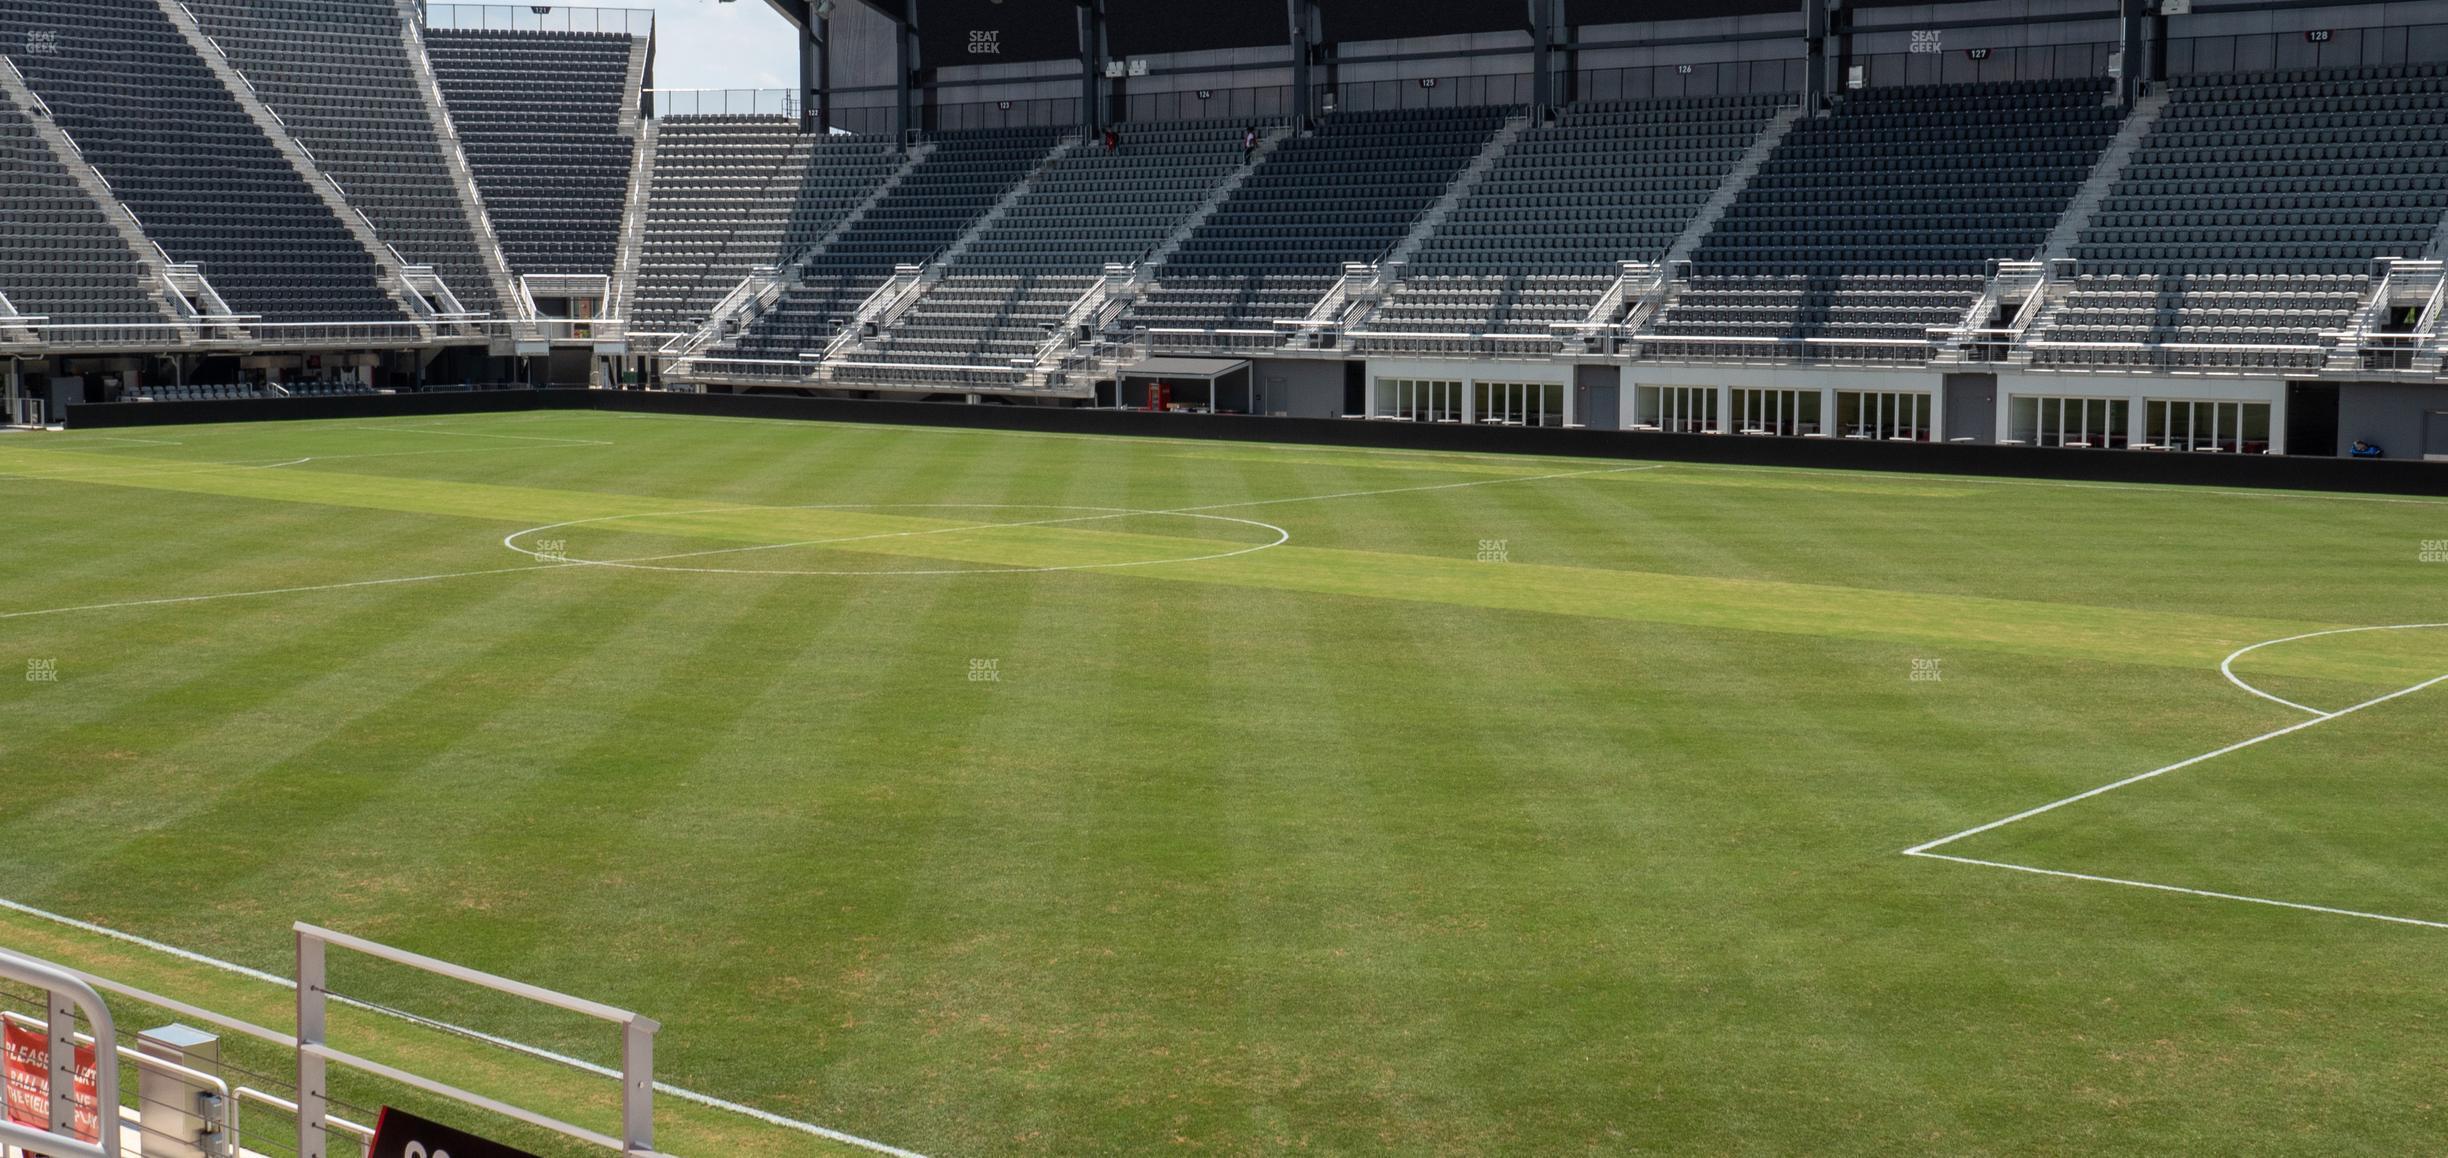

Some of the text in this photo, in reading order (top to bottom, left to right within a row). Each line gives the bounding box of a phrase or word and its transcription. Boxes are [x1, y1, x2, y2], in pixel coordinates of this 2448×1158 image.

[2311, 31, 2328, 40] 128
[1971, 49, 1986, 58] 127
[1678, 65, 1692, 74] 126
[1422, 79, 1434, 87] 125
[1199, 90, 1210, 98] 124
[1000, 101, 1010, 109] 123
[10, 1070, 37, 1092] BALL
